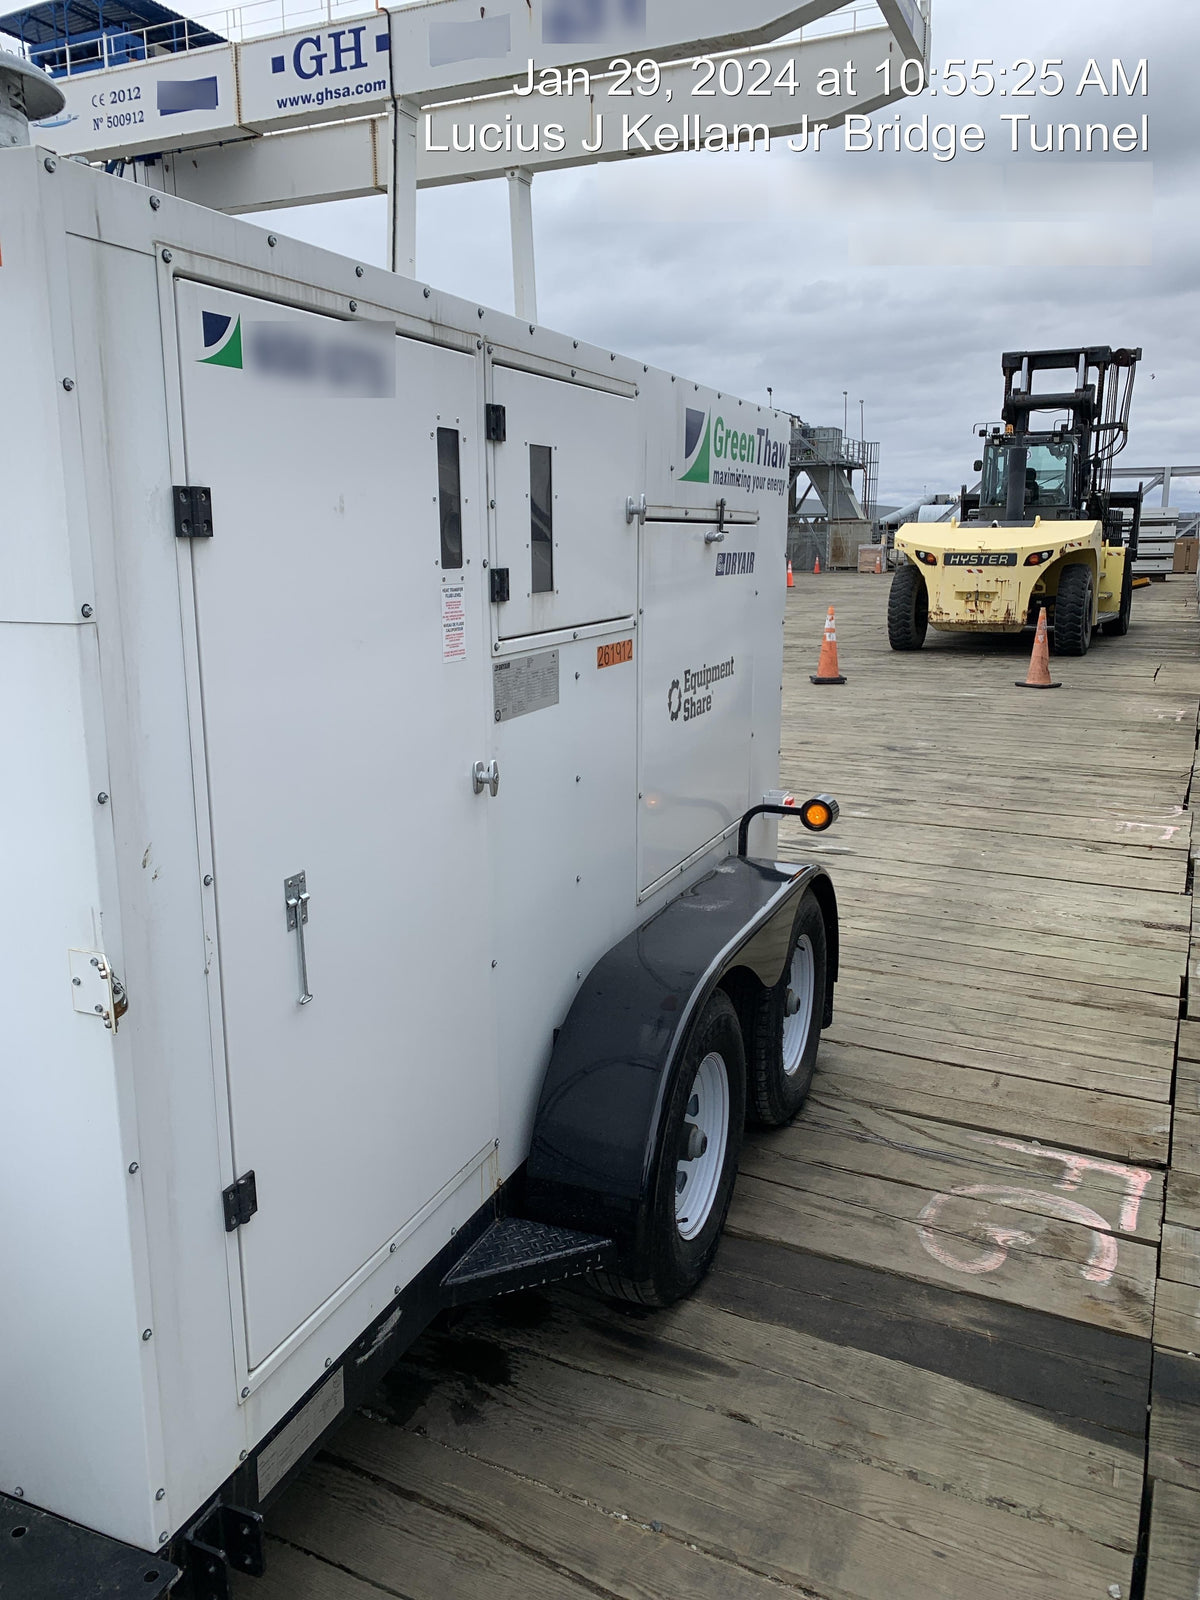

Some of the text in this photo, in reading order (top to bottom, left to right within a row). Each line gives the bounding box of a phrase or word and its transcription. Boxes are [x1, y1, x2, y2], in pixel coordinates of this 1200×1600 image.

[292, 25, 368, 80] GH
[110, 86, 141, 104] 2012
[276, 79, 387, 109] www.ghsa.com
[106, 110, 144, 129] 500912
[712, 466, 786, 497] maximizing your energy
[725, 551, 755, 576] DRYAIR
[949, 554, 1009, 565] HYSTER
[597, 639, 633, 667] 261912
[684, 655, 735, 695] Equipment
[683, 696, 712, 722] Share
